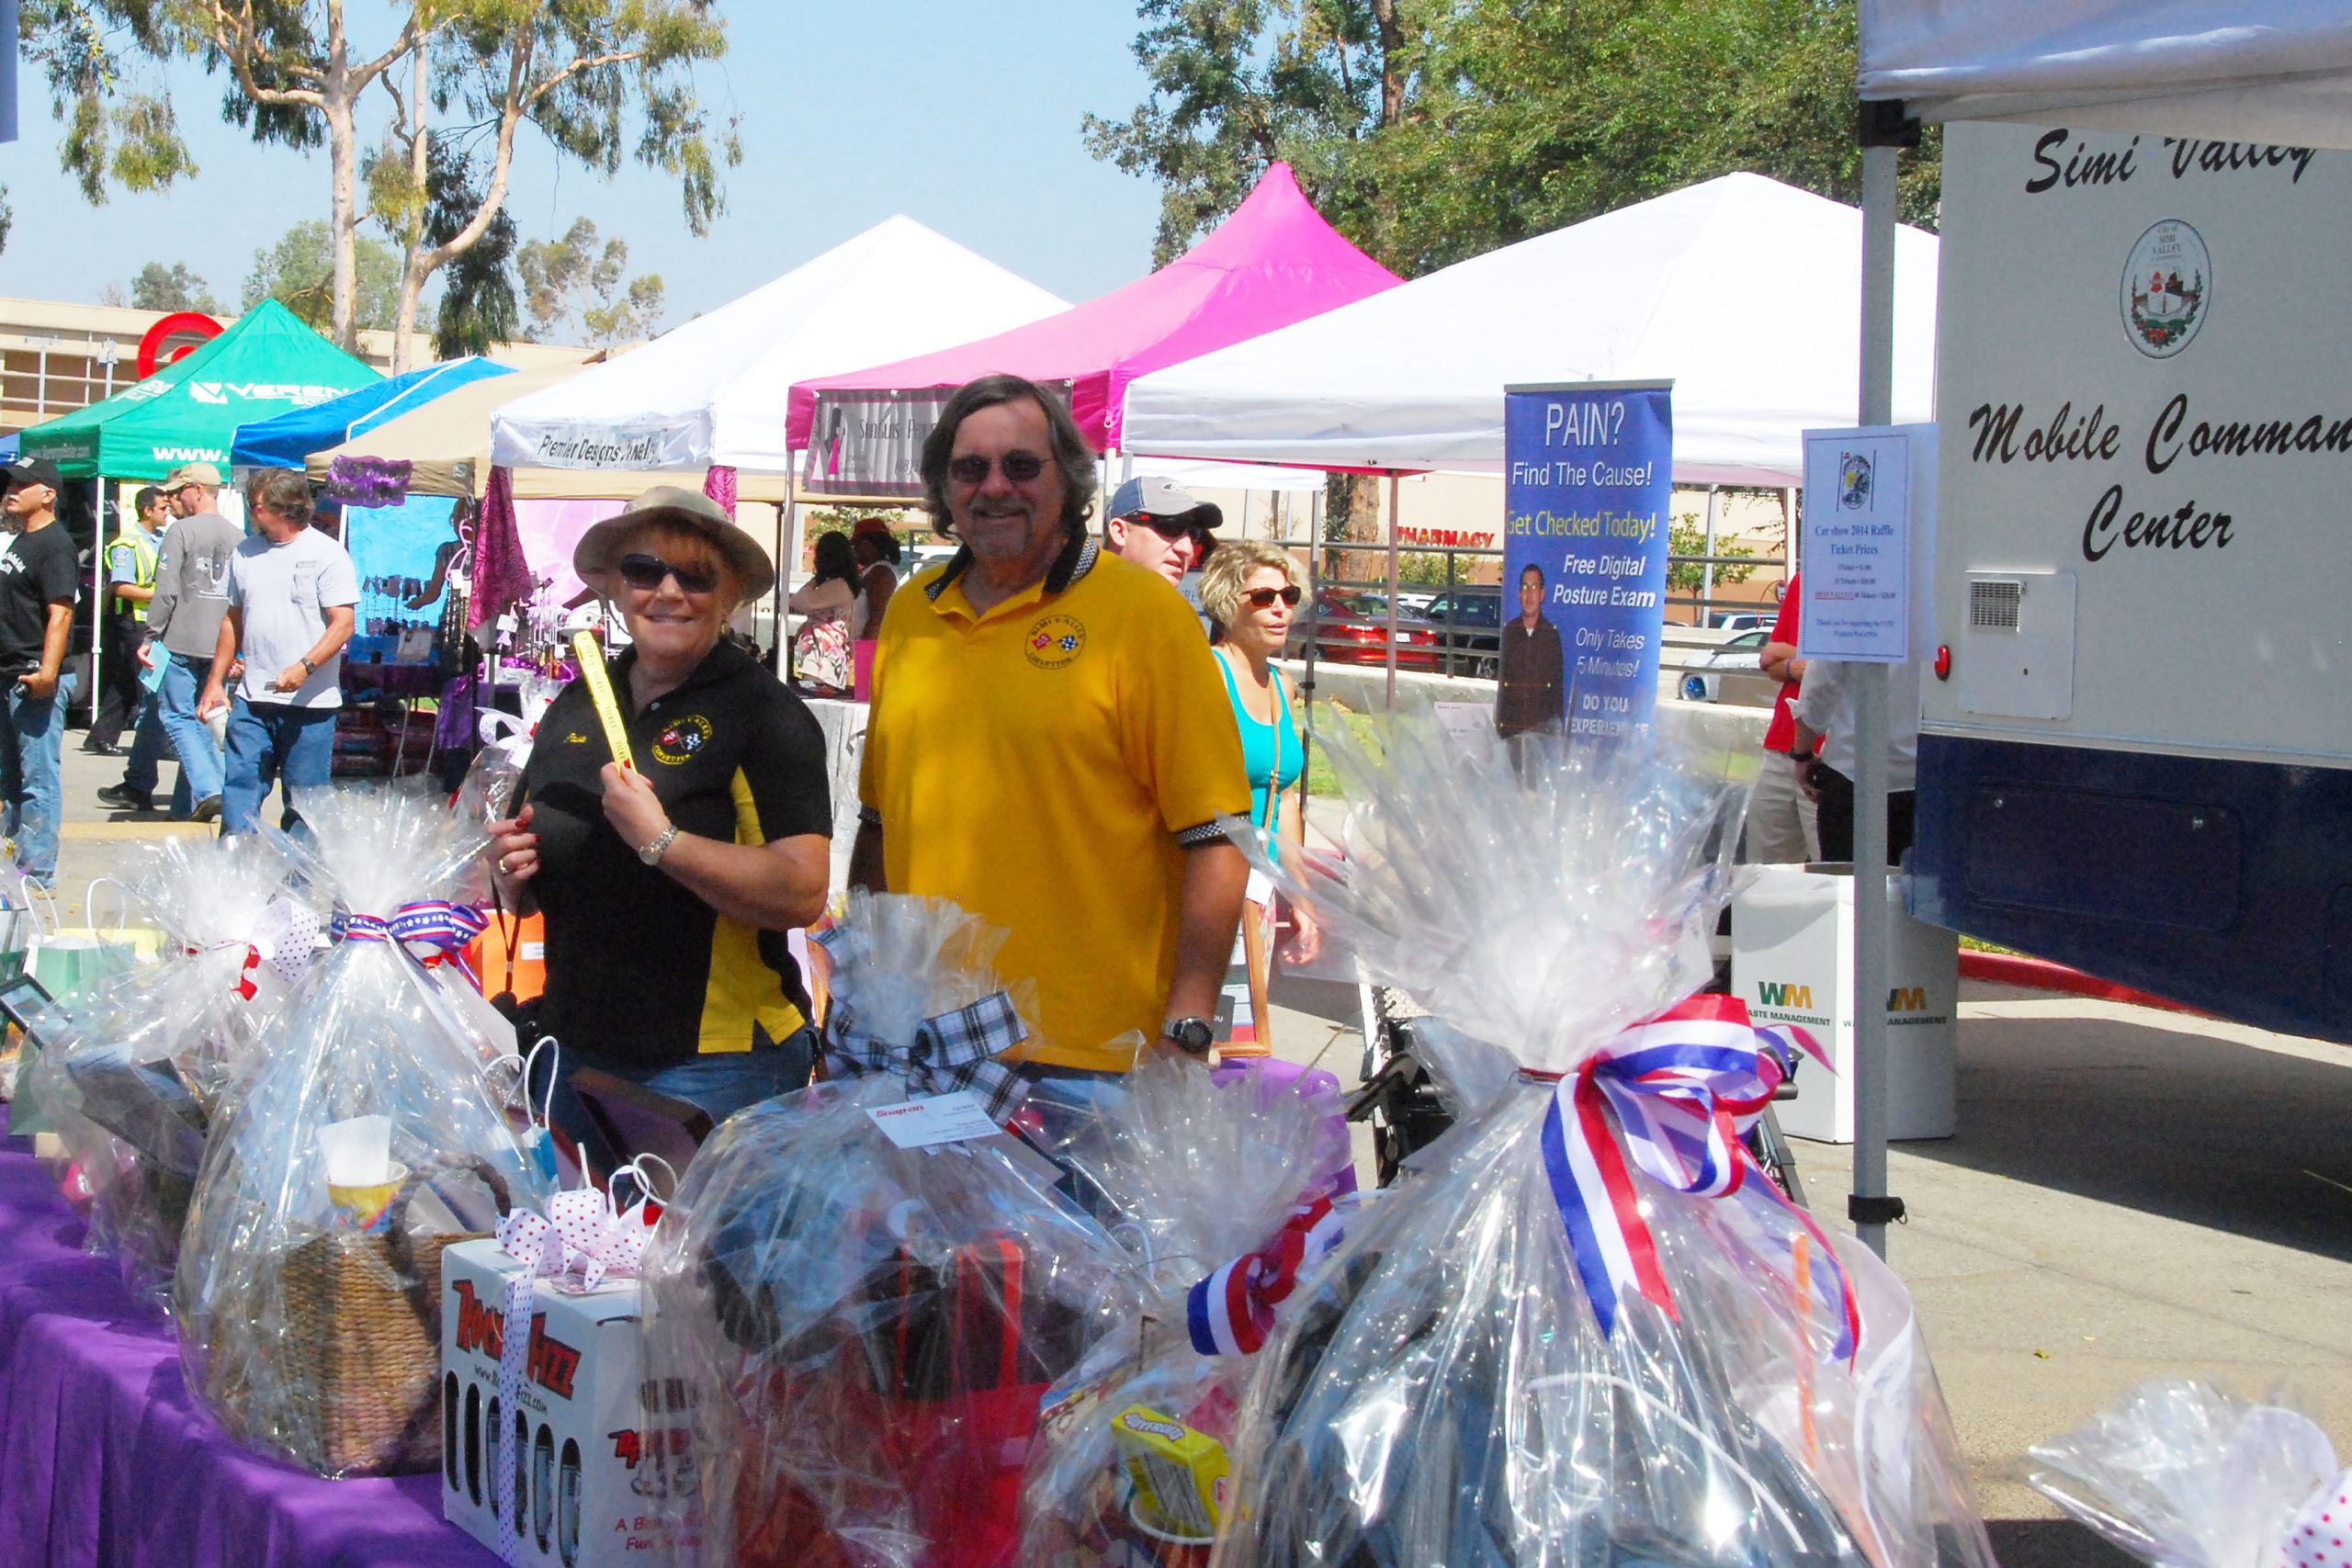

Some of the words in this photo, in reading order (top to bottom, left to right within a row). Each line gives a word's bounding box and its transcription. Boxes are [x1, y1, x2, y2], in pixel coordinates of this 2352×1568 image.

[2025, 128, 2141, 194] Simi
[1544, 400, 1625, 447] PAIN?
[1969, 400, 2121, 464] Mobile
[152, 446, 230, 462] www.
[538, 434, 580, 460] Premier
[577, 438, 622, 468] Designs
[1512, 462, 1551, 487] Find
[1555, 462, 1587, 487] The
[1591, 461, 1654, 487] Cause!
[1506, 511, 1532, 536] Get
[1535, 511, 1600, 537] Checked
[1602, 512, 1657, 545] Today!
[1815, 525, 1829, 537] Car
[1832, 525, 1849, 537] show
[1851, 525, 1870, 537] 2014
[1871, 525, 1894, 537] Raffle
[2081, 483, 2234, 562] Center
[1396, 525, 1496, 548] PHARMACY
[1831, 545, 1853, 556] Ticket
[1855, 545, 1878, 556] Prices
[1563, 555, 1597, 575] Free
[1599, 556, 1647, 581] Digital
[1553, 584, 1609, 606] Posture
[1611, 586, 1657, 609] Exam
[1576, 627, 1604, 652] Only
[1607, 629, 1645, 650] Takes
[1577, 656, 1585, 675] 5
[1587, 656, 1641, 678] Minutes!
[1582, 695, 1599, 711] DO
[1603, 696, 1629, 714] YOU
[1758, 981, 1813, 1009] WM
[1747, 1009, 1768, 1020] ASTE
[1770, 1011, 1831, 1026] MANAGEMENT
[1886, 1015, 1948, 1026] ANAGEMENT
